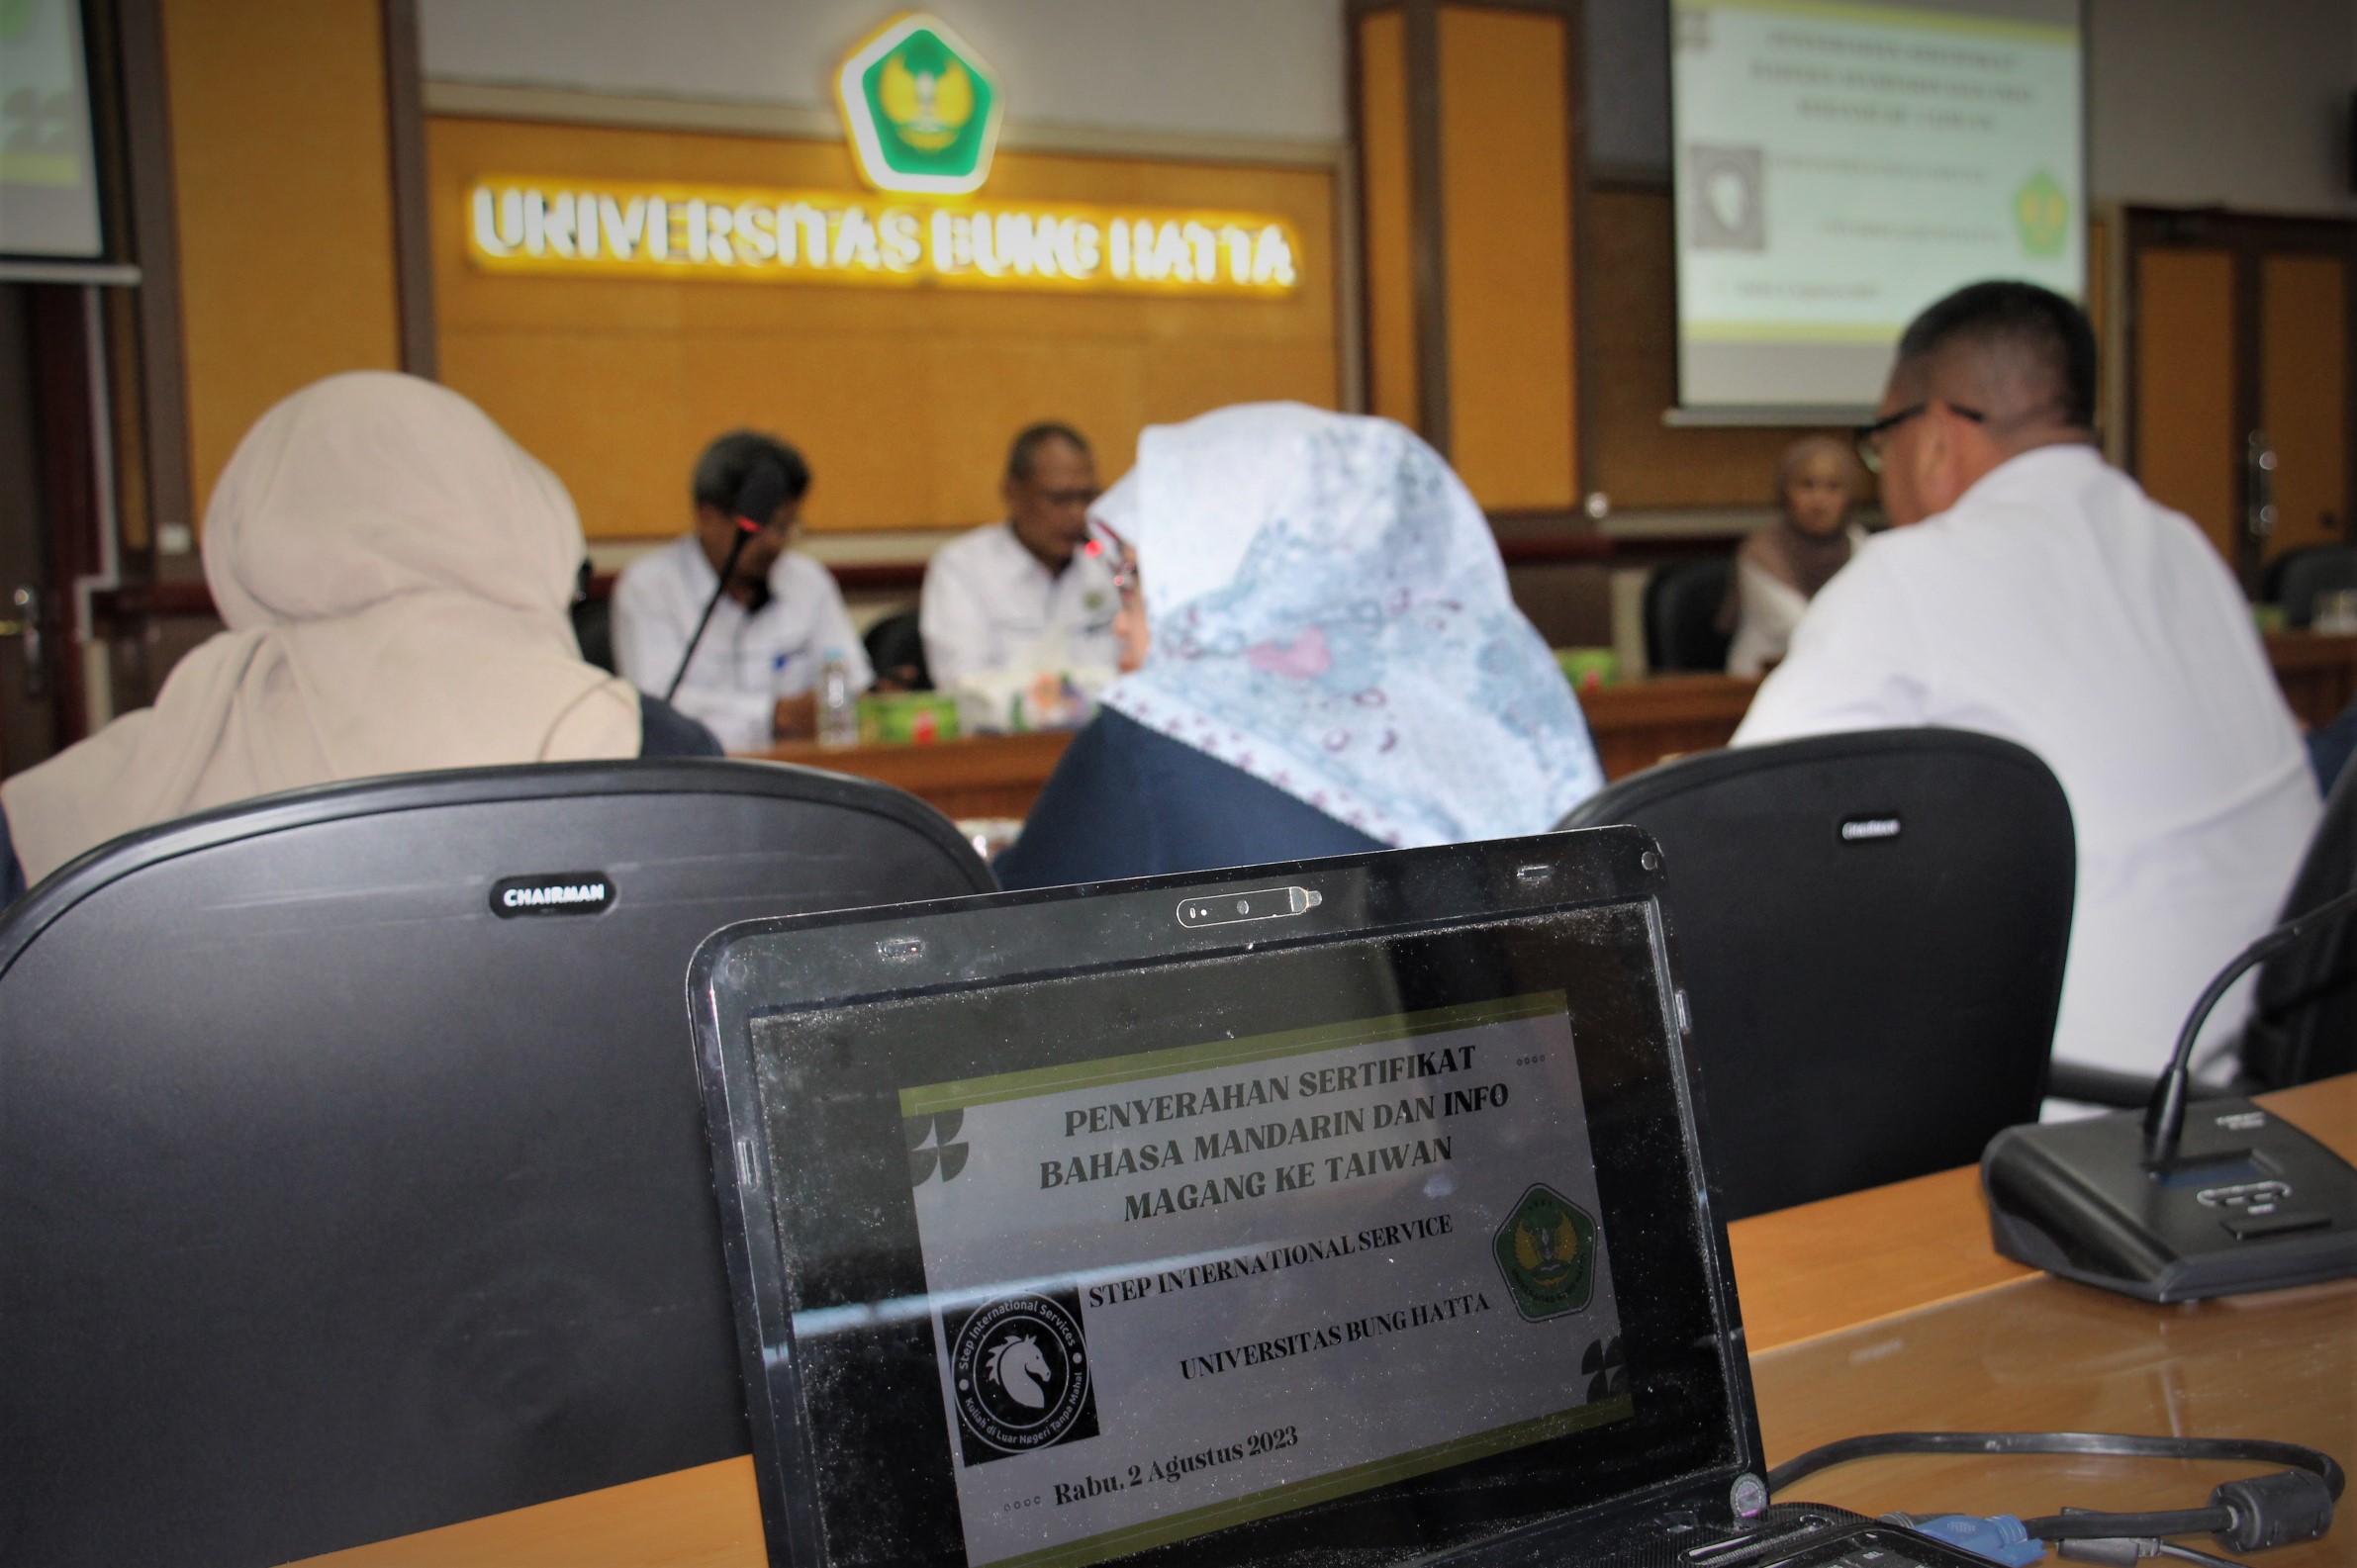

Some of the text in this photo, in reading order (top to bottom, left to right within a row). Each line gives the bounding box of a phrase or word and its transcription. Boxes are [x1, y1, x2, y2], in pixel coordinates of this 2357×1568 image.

[473, 187, 921, 271] UNIVERSITAS
[1109, 217, 1296, 287] HATTA
[503, 883, 606, 907] CHAIRMAN
[1064, 1045, 1477, 1137] PENYERAHAN SERTIFIKAT
[1039, 1082, 1510, 1189] BAHASA MANDARIN DAN INFO
[1124, 1136, 1453, 1222] MAGANG KE TAIWAN
[1089, 1213, 1454, 1309] STEP INTERNATIONAL SERVICE
[959, 1300, 1077, 1371] Step International Services
[1179, 1291, 1491, 1380] UNIVERSITAS BUNG HATTA
[965, 1397, 988, 1430] Kuliah
[986, 1427, 997, 1438] di
[995, 1430, 1018, 1444] Luar
[1050, 1407, 1075, 1432] Tanpa
[1072, 1371, 1083, 1406] Mahal
[1127, 1464, 1143, 1486] 2
[1148, 1443, 1244, 1483] Agustus
[1246, 1425, 1299, 1456] 2023
